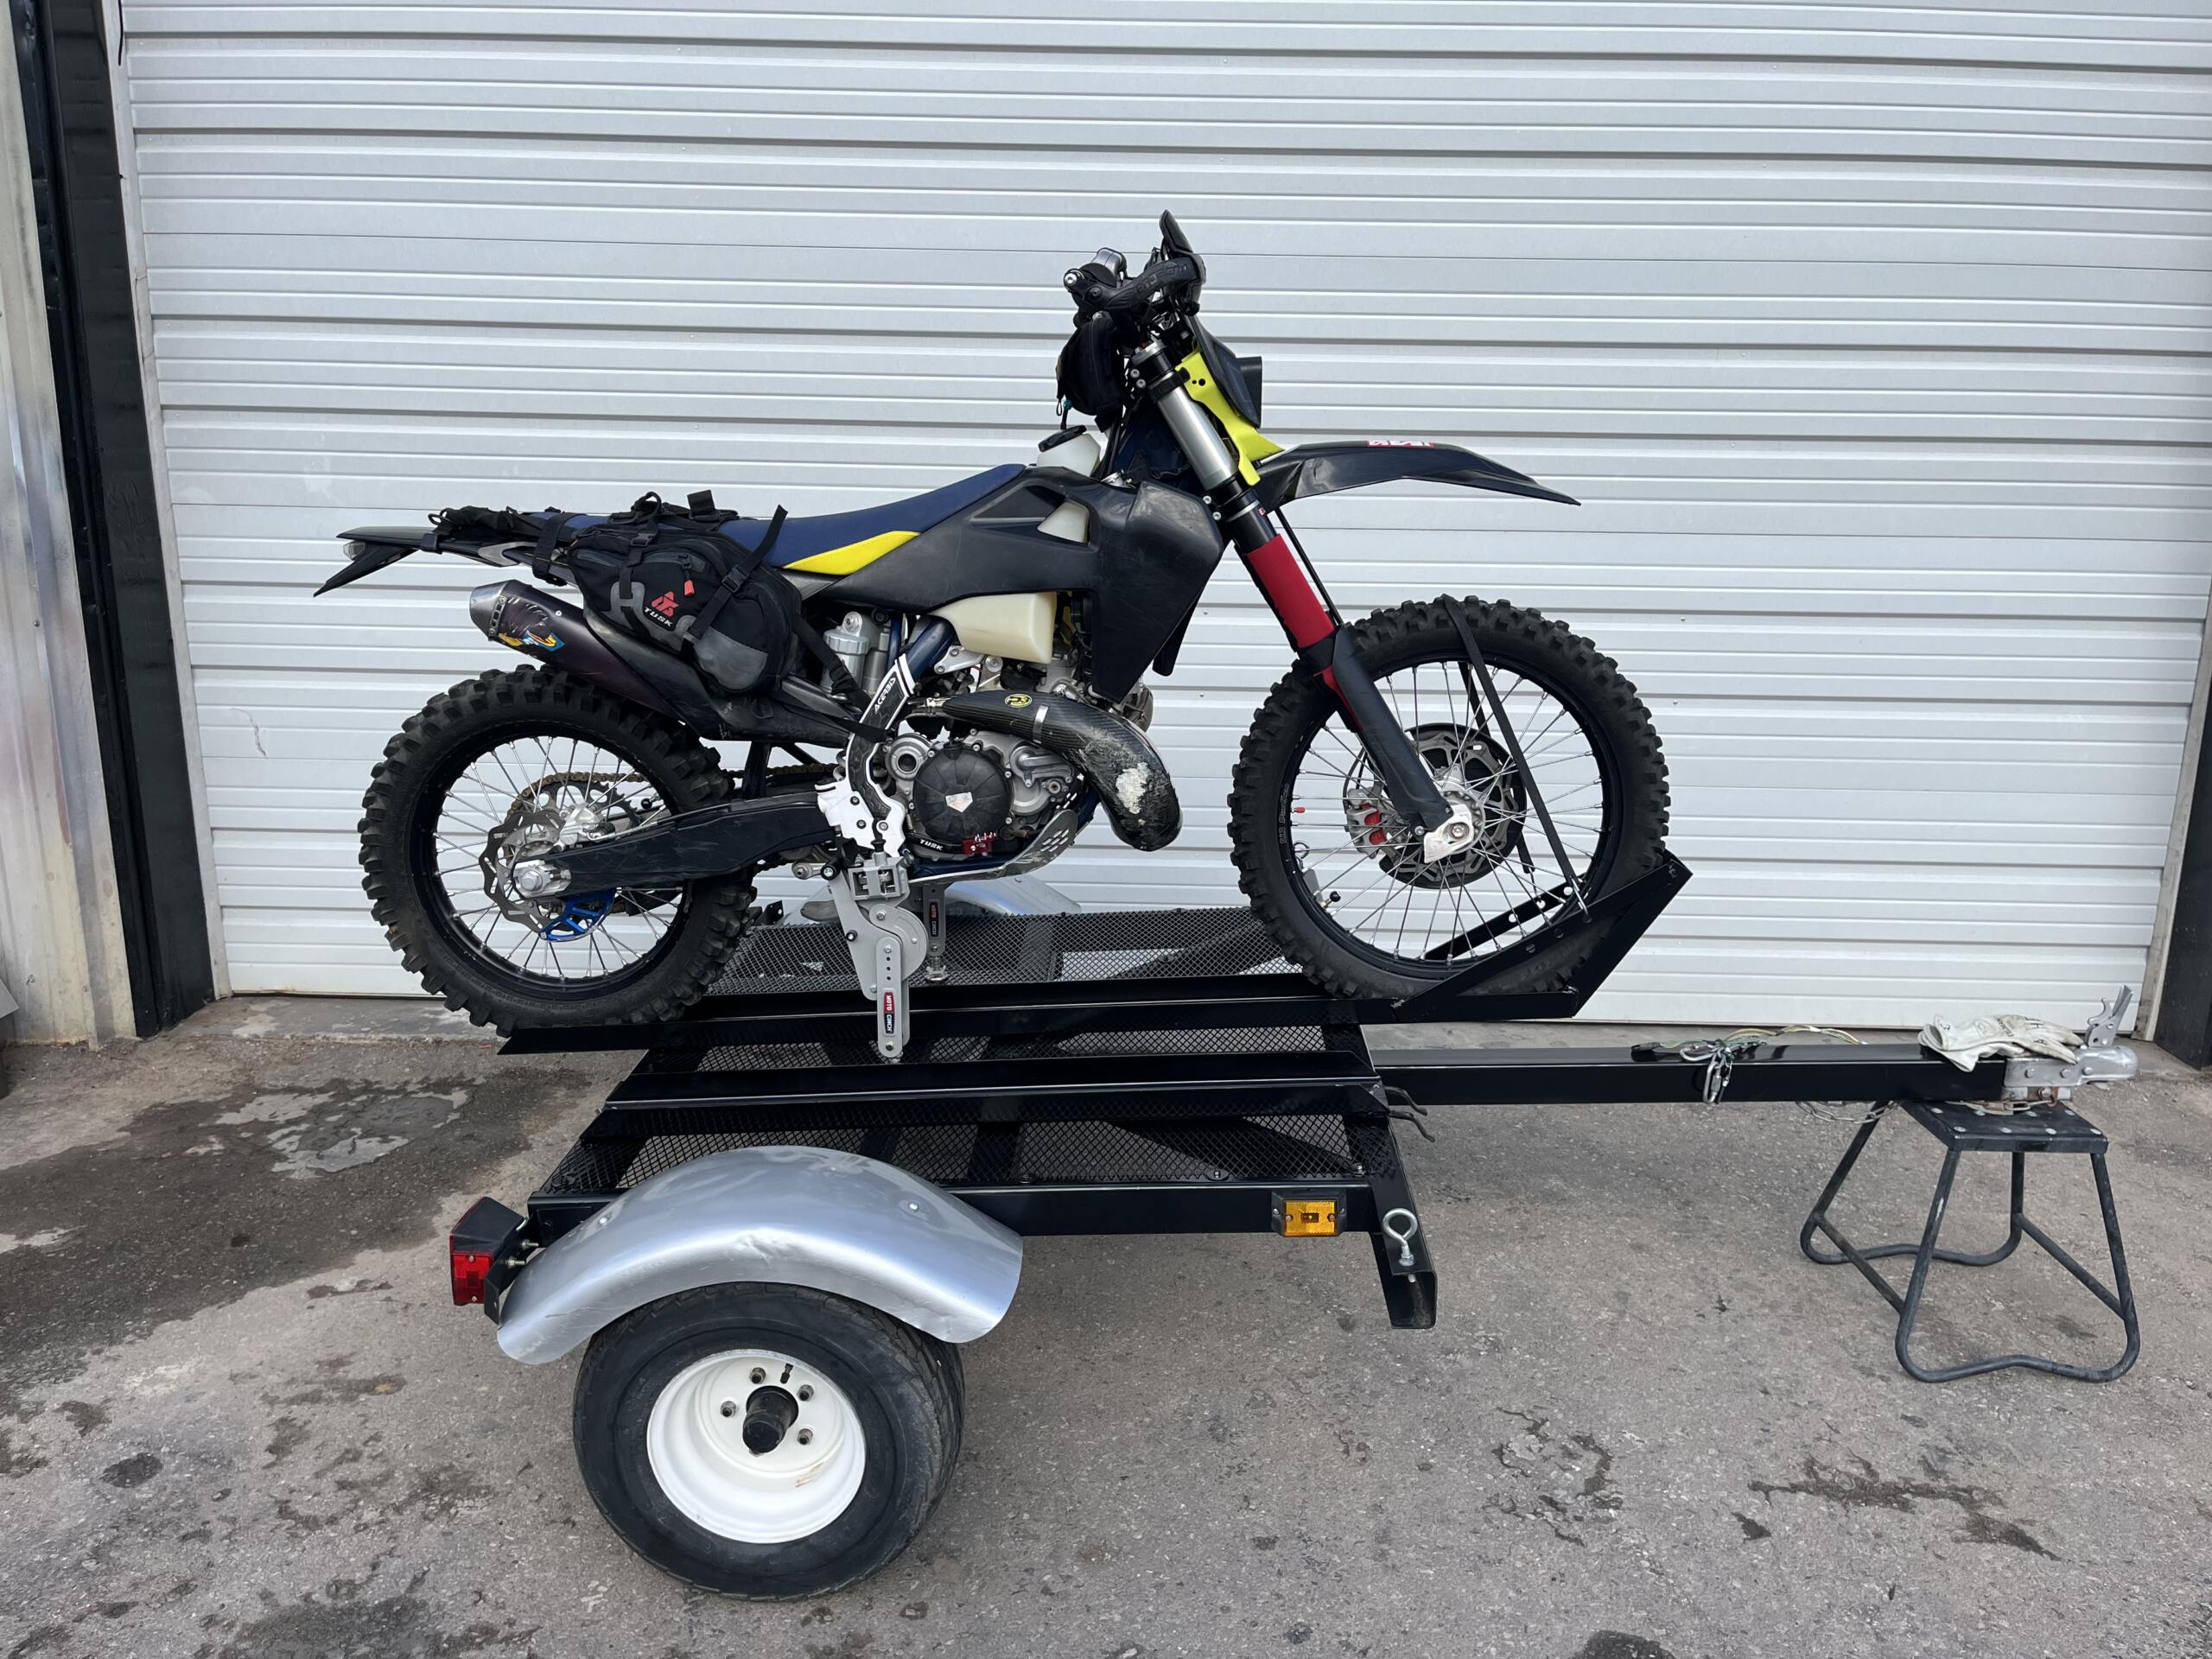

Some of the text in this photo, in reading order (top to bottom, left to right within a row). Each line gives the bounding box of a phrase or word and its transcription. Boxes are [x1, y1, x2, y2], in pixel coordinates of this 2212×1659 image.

[645, 607, 673, 627] TUSK
[874, 677, 896, 715] ACERBIS
[919, 839, 944, 851] TUSK
